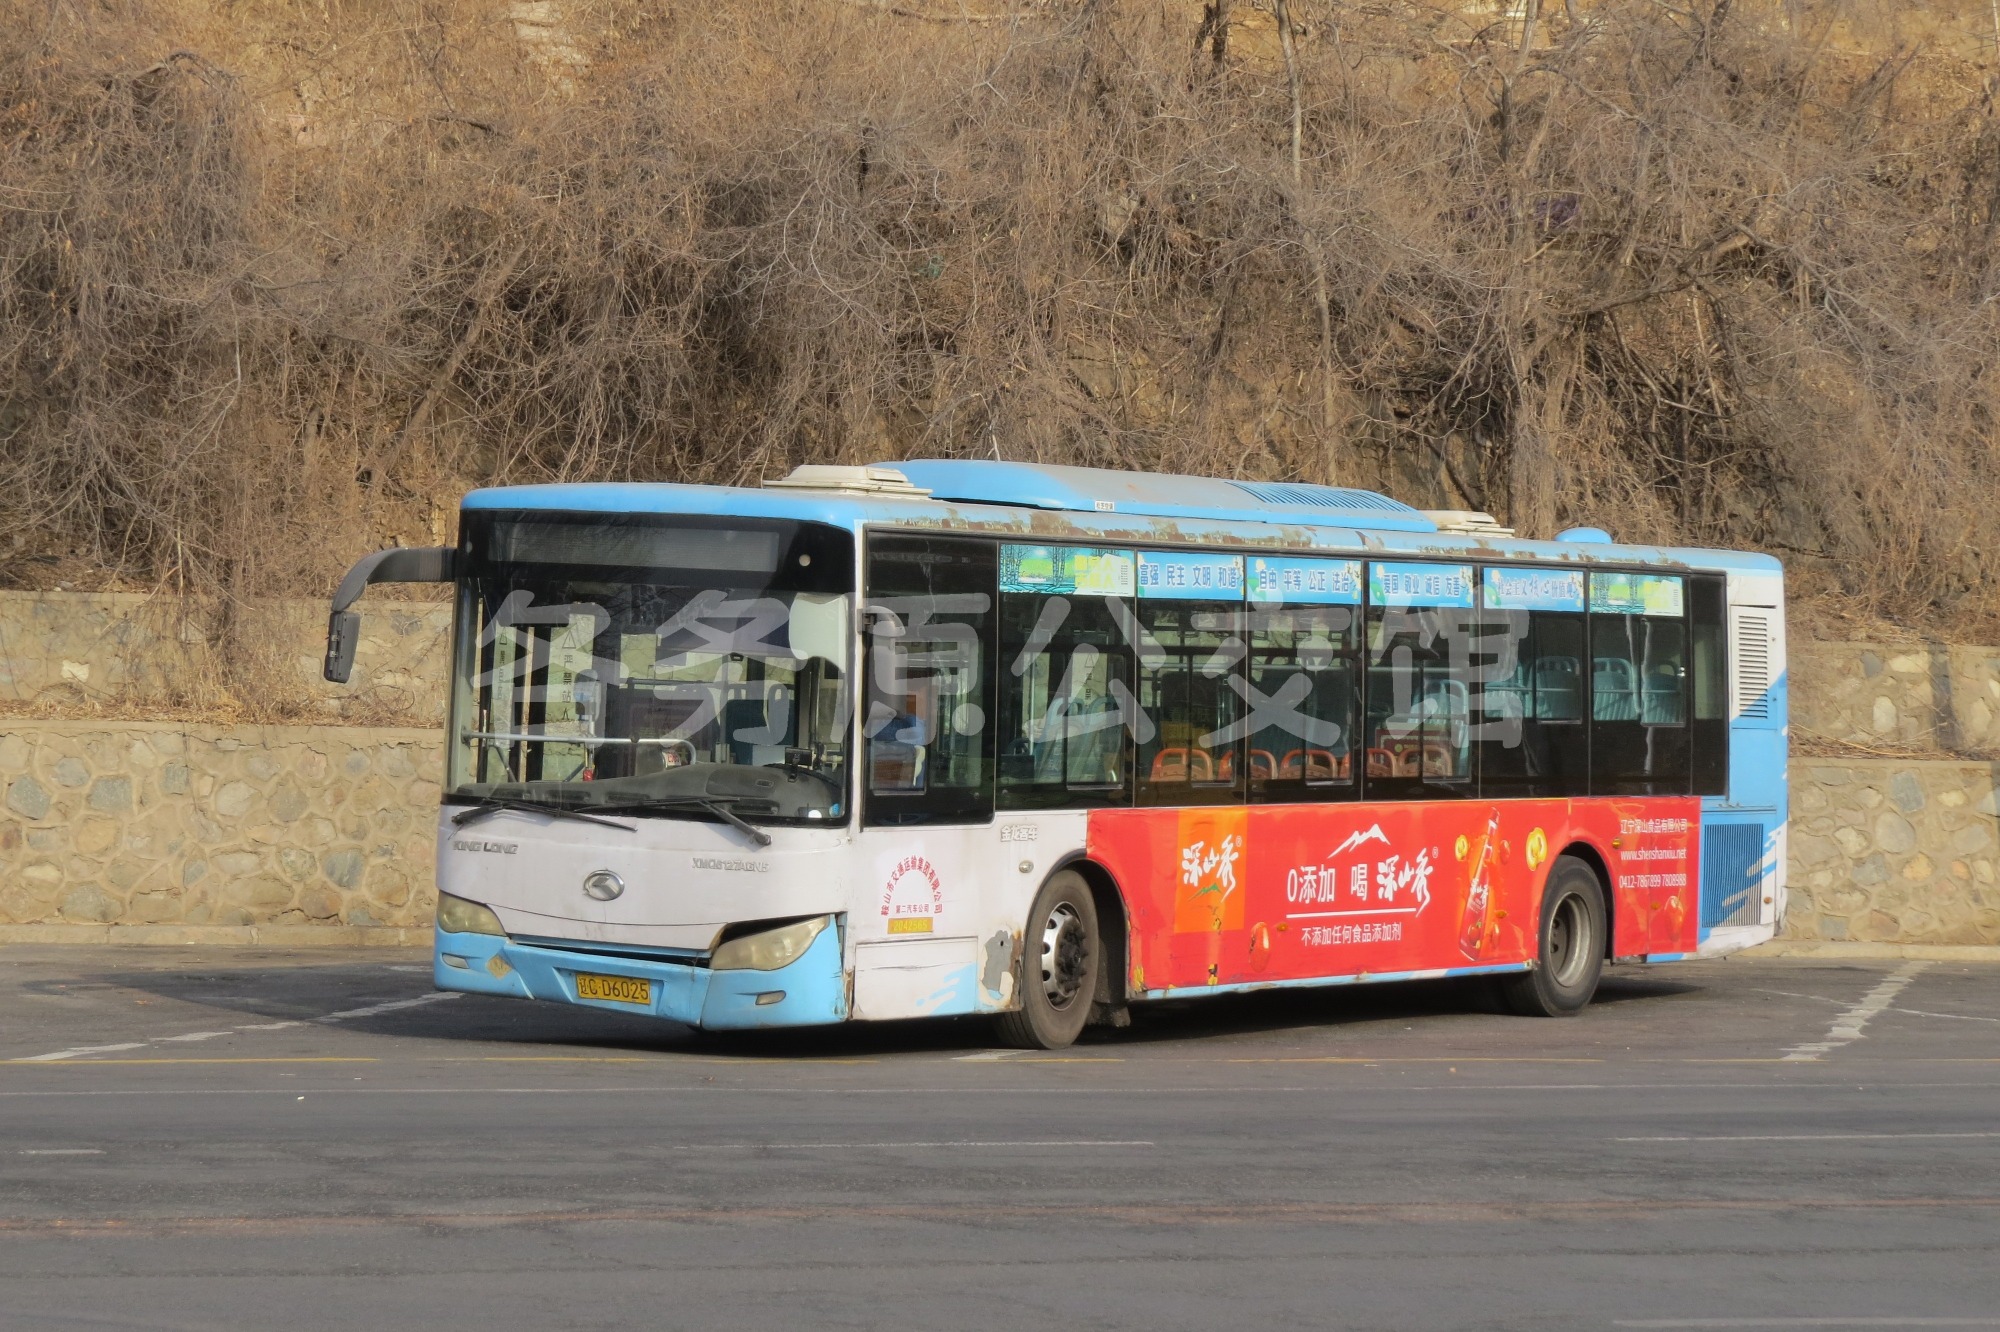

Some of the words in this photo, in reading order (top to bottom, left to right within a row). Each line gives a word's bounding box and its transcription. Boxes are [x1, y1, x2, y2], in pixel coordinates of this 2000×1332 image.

[1139, 564, 1160, 587] 富强
[1166, 564, 1185, 587] 民主
[1192, 566, 1211, 588] 文明
[1218, 566, 1238, 589] 和谐
[1259, 568, 1277, 590] 自由
[1284, 569, 1302, 591] 平等
[1308, 570, 1326, 592] 公正
[1332, 571, 1350, 593] 法治
[1383, 573, 1399, 596] 爱国
[1404, 573, 1420, 596] 敬业
[1424, 574, 1440, 597] 诚信
[1445, 574, 1460, 598] 友善
[1620, 818, 1687, 834] 辽宁深山食品有限公司
[453, 840, 482, 852] KING
[483, 841, 519, 855] LONG
[1620, 846, 1687, 861] www.shenshanxiu.net
[881, 855, 943, 916] 鞍山市交通运输集团有限公司
[1287, 864, 1336, 904] 0添加
[1351, 863, 1368, 901] 喝
[1301, 921, 1402, 946] 不添加任何食品添加剂
